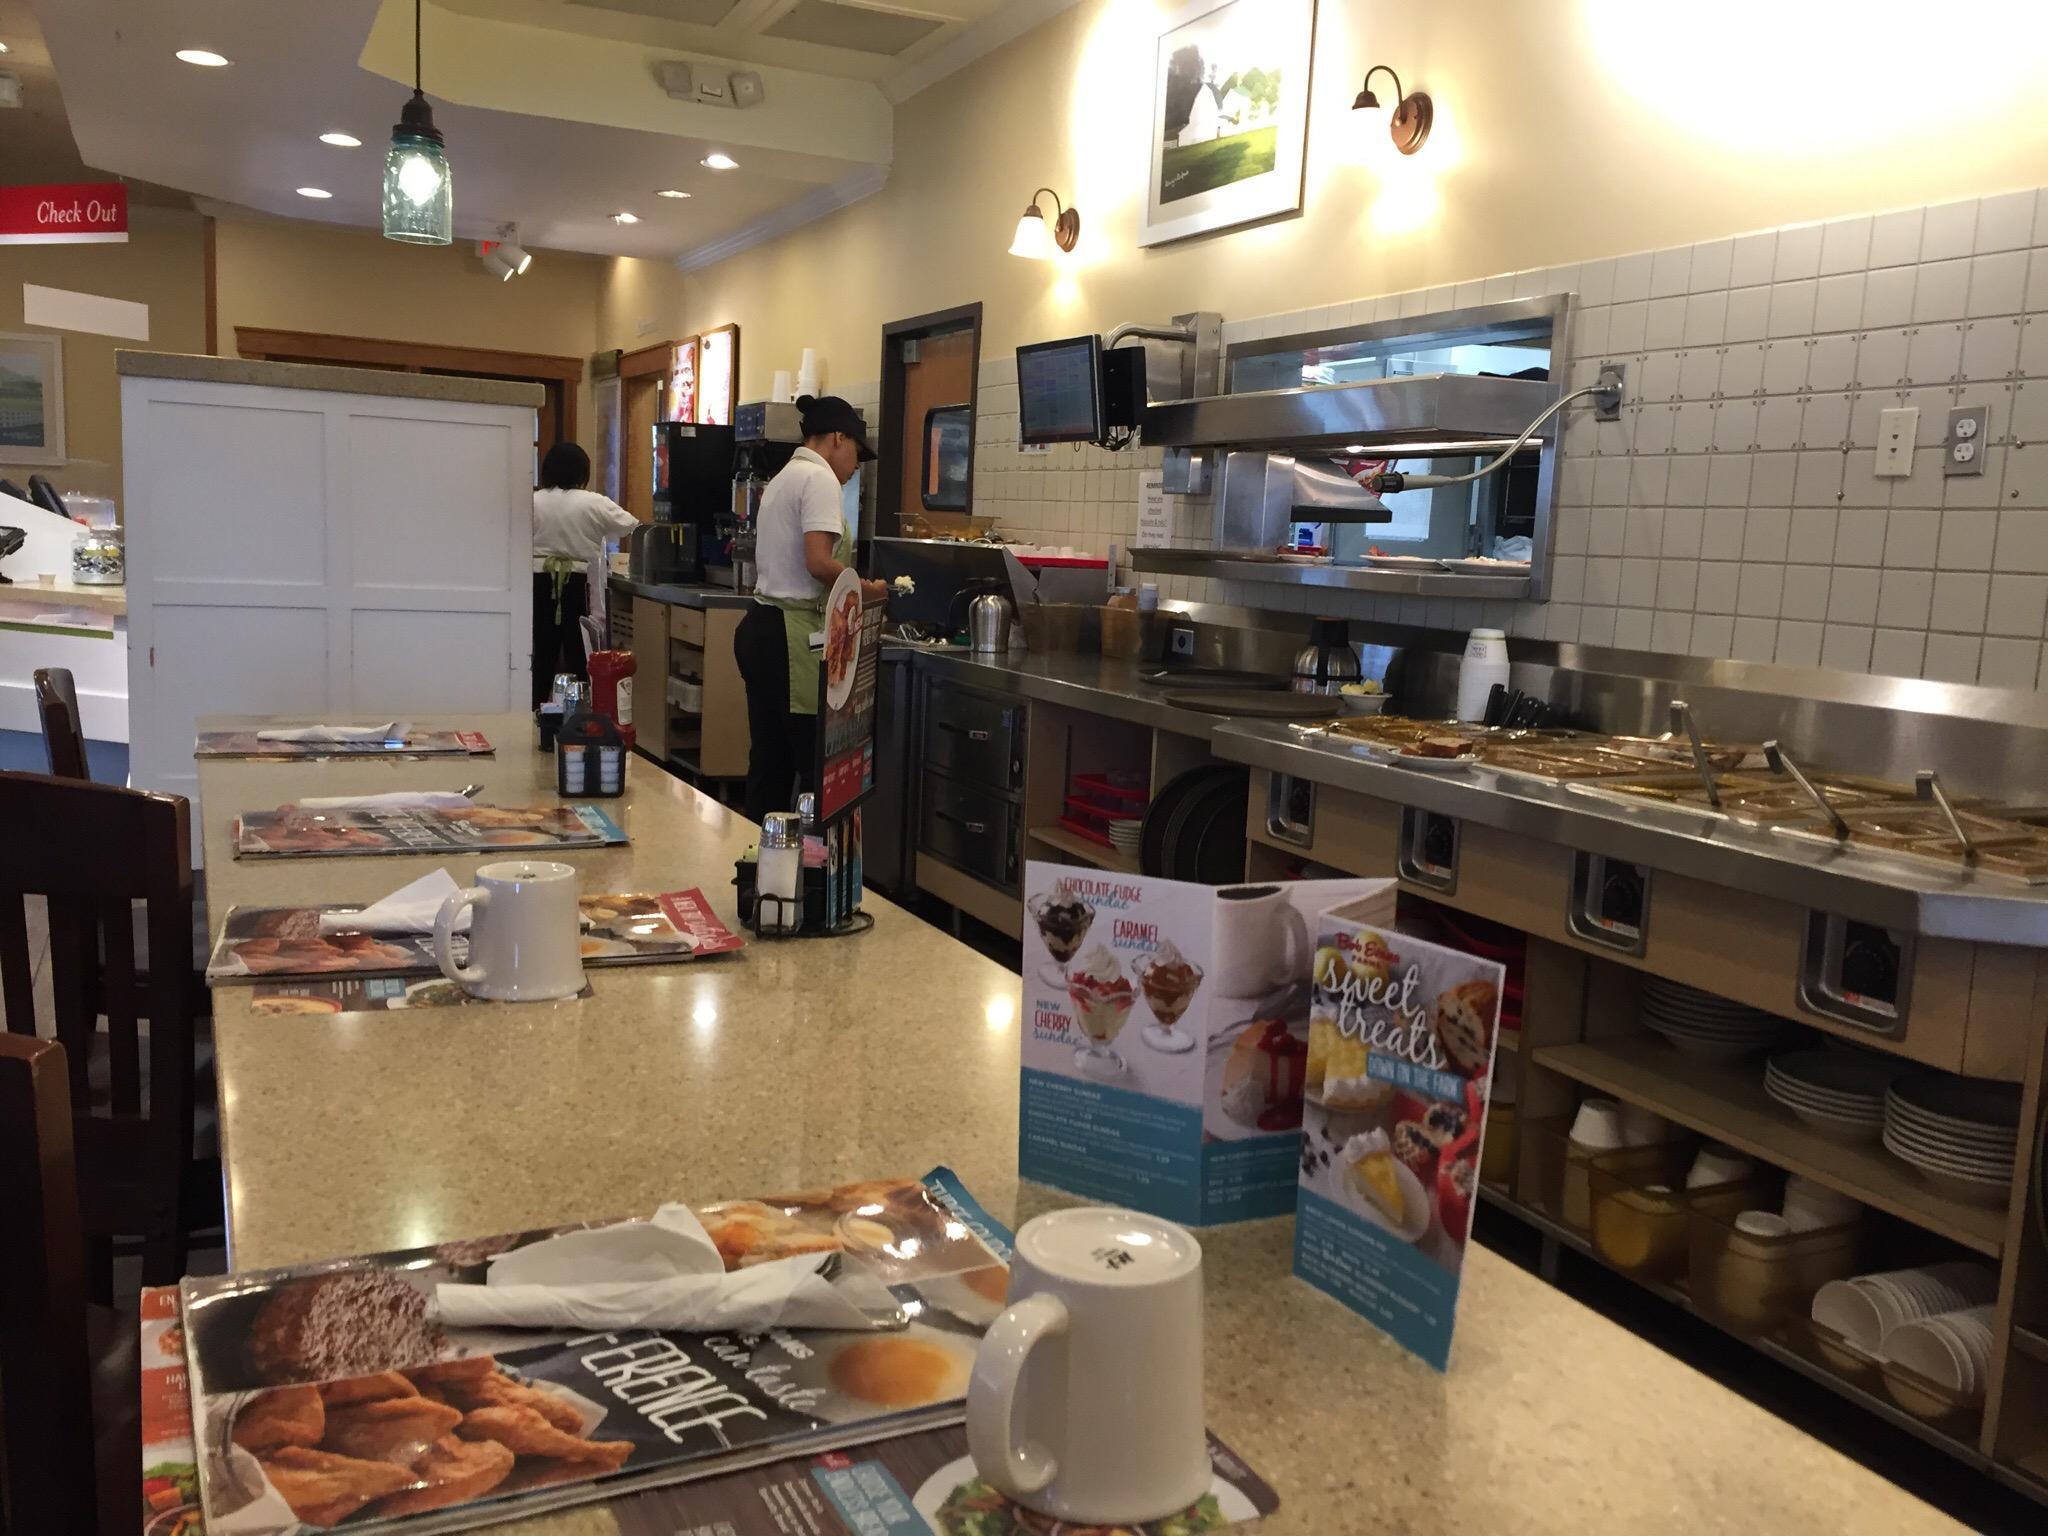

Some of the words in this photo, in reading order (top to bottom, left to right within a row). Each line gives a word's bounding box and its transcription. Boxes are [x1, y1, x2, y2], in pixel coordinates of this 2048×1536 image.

[37, 200, 82, 223] Check
[86, 199, 118, 222] Out
[1064, 876, 1112, 898] CHOCOLATE
[1114, 886, 1142, 902] FUDGE
[1080, 891, 1129, 910] sundae
[1113, 919, 1159, 943] CARAMEL
[1335, 931, 1362, 952] Bob
[1322, 957, 1420, 1017] sweet
[1035, 999, 1061, 1011] NEW
[1034, 1010, 1072, 1033] CHERRY
[1338, 992, 1448, 1071] treats
[1032, 1027, 1083, 1047] sundae
